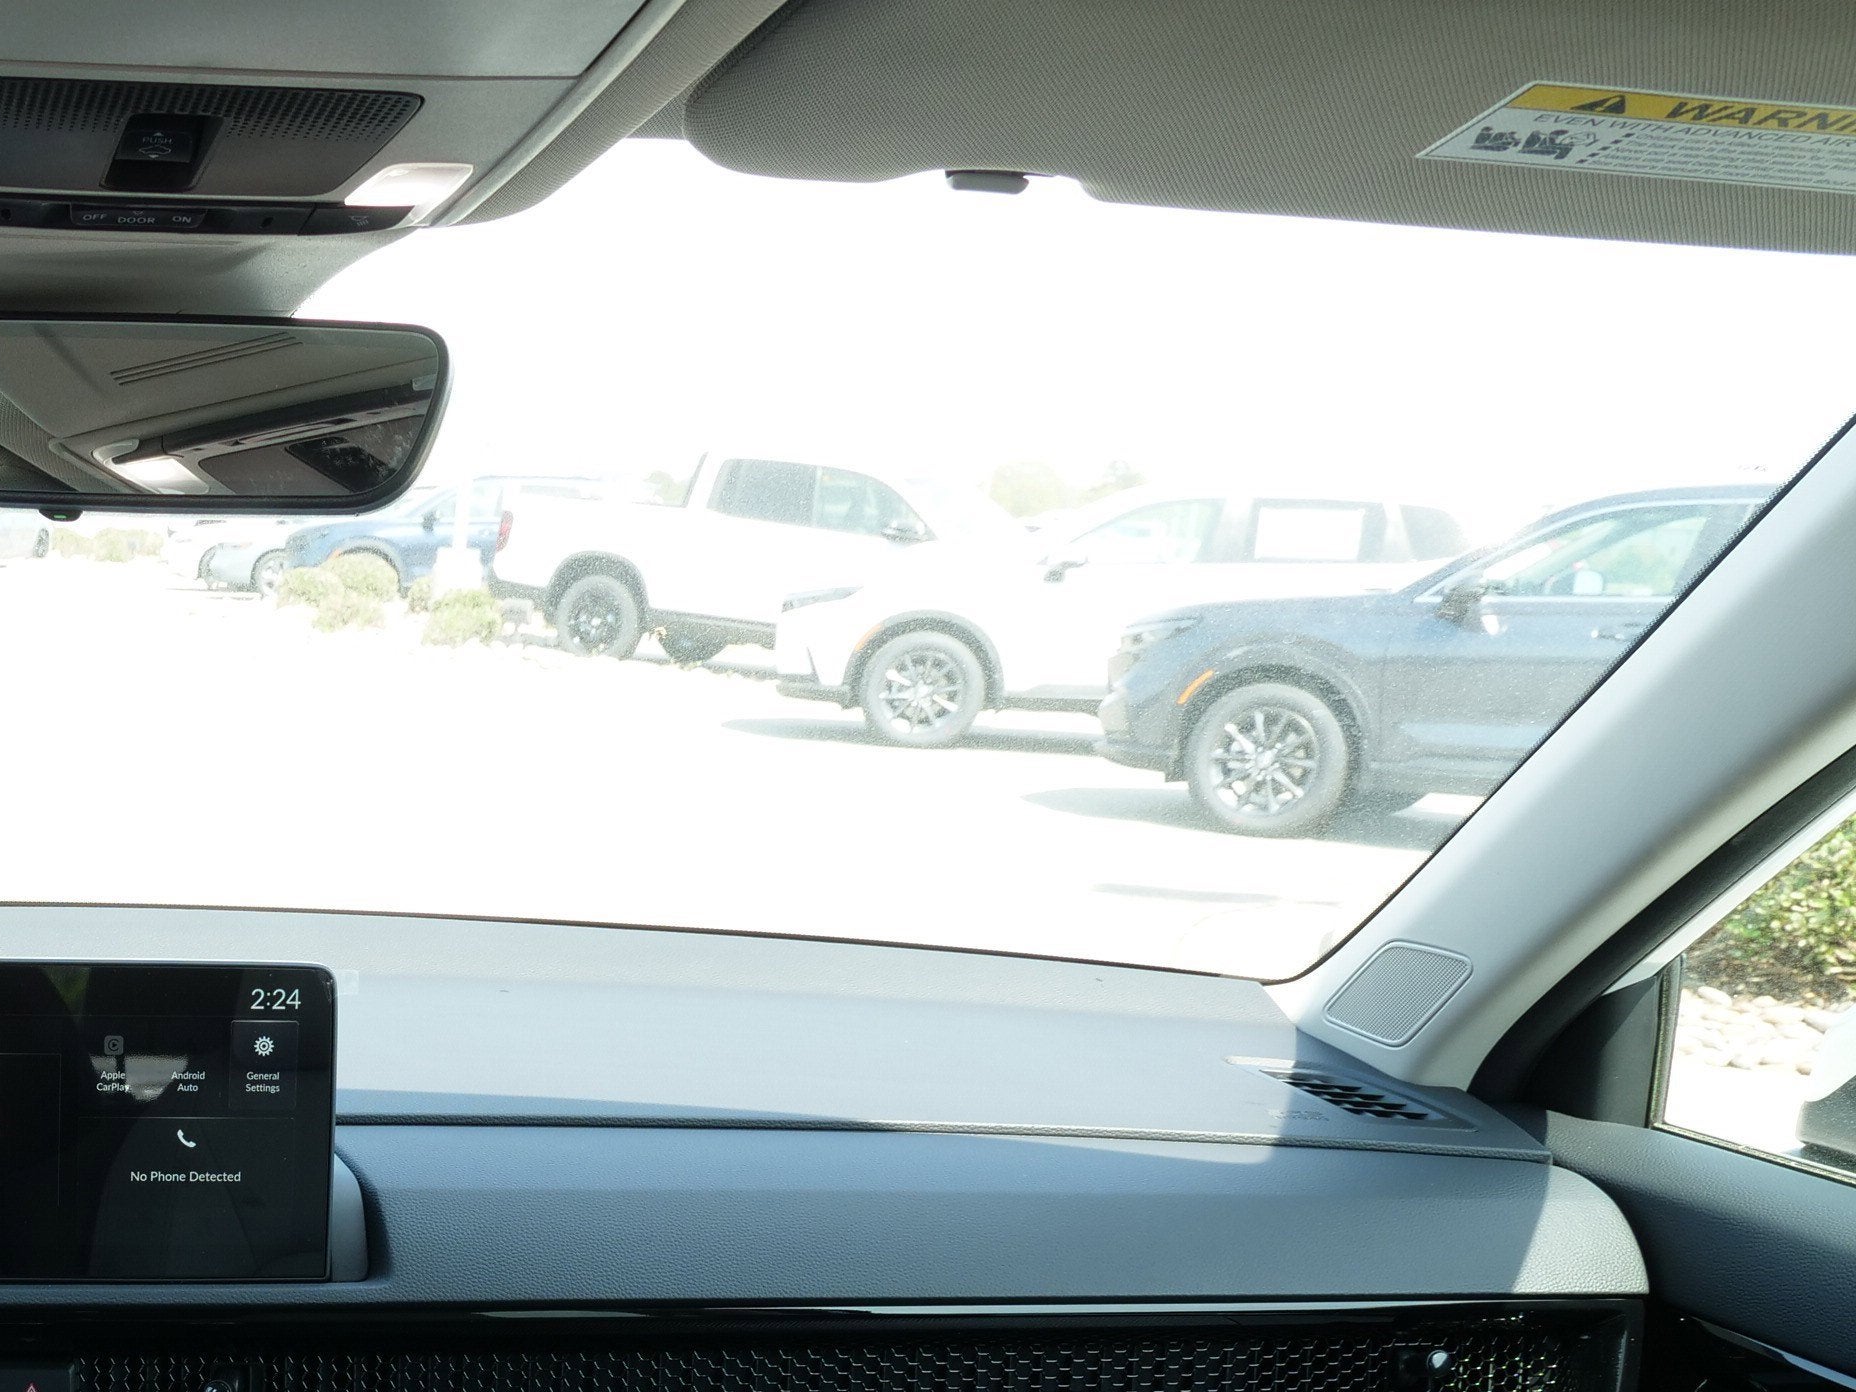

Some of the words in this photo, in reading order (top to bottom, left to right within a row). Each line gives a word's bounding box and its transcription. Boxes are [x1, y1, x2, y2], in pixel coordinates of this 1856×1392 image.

[1534, 114, 1605, 127] EVEN
[1609, 120, 1675, 133] WITH
[1673, 126, 1813, 144] ADVANCED
[83, 213, 107, 221] OFF
[117, 216, 156, 224] DOOR
[172, 215, 192, 223] ON
[250, 988, 302, 1010] 2:24
[100, 1070, 126, 1082] Apple
[171, 1070, 205, 1080] Android
[246, 1070, 280, 1080] General
[96, 1083, 130, 1093] CarPlay
[177, 1083, 199, 1092] Auto
[245, 1083, 280, 1094] Settings
[130, 1171, 145, 1182] No
[149, 1171, 185, 1182] Phone
[189, 1170, 241, 1182] Detected
